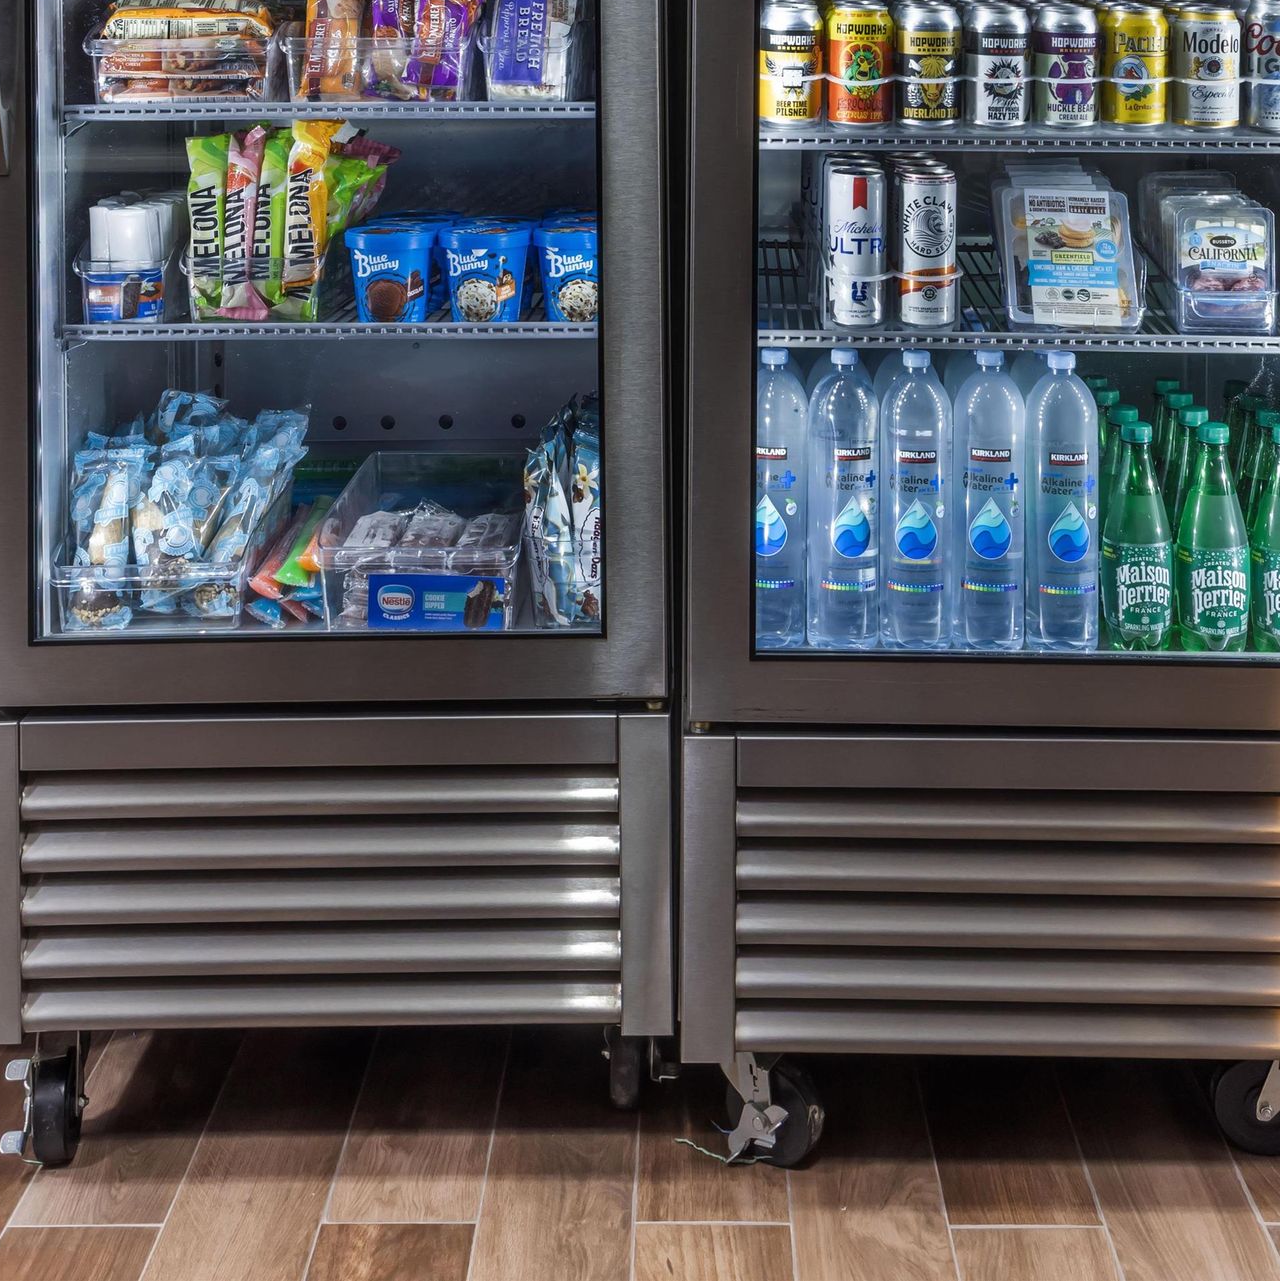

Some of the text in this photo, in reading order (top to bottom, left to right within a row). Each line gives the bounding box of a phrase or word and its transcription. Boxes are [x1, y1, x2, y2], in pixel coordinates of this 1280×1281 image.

[836, 23, 887, 35] HOPWORKS
[516, 6, 531, 64] BREAD
[528, 1, 544, 70] FRENCH
[770, 35, 816, 46] HOPWORKS
[910, 36, 956, 47] HOPWORKS
[982, 37, 1027, 49] HOPWORKS
[1051, 37, 1097, 48] HOPWORKS
[1182, 31, 1239, 55] Modelo
[776, 107, 808, 117] PILSNER
[904, 107, 946, 119] OVERLAND
[1047, 103, 1077, 113] HUCKLE
[987, 111, 1020, 121] HAZY IPA
[288, 168, 316, 268] MELONA
[903, 198, 922, 234] WHITE
[190, 184, 221, 278] MELONA
[911, 241, 932, 255] HARD
[1188, 245, 1258, 261] CALIFORNIA
[357, 258, 400, 278] Bunny
[449, 258, 489, 277] Bunny
[549, 258, 594, 278] Bunny
[834, 447, 870, 458] KIRKLAND
[897, 450, 937, 460] KIRKLAND
[971, 449, 1011, 460] KIRKLAND
[1050, 453, 1089, 463] KIRKLAND
[1041, 477, 1084, 488] Alkaline
[1041, 486, 1073, 496] Water
[1116, 562, 1170, 587] Maison
[1191, 566, 1246, 591] Maison
[1130, 606, 1161, 614] FRANCE
[1205, 610, 1238, 618] FRANCE
[382, 612, 411, 621] CLASSICS
[1200, 626, 1226, 635] SPARKLING
